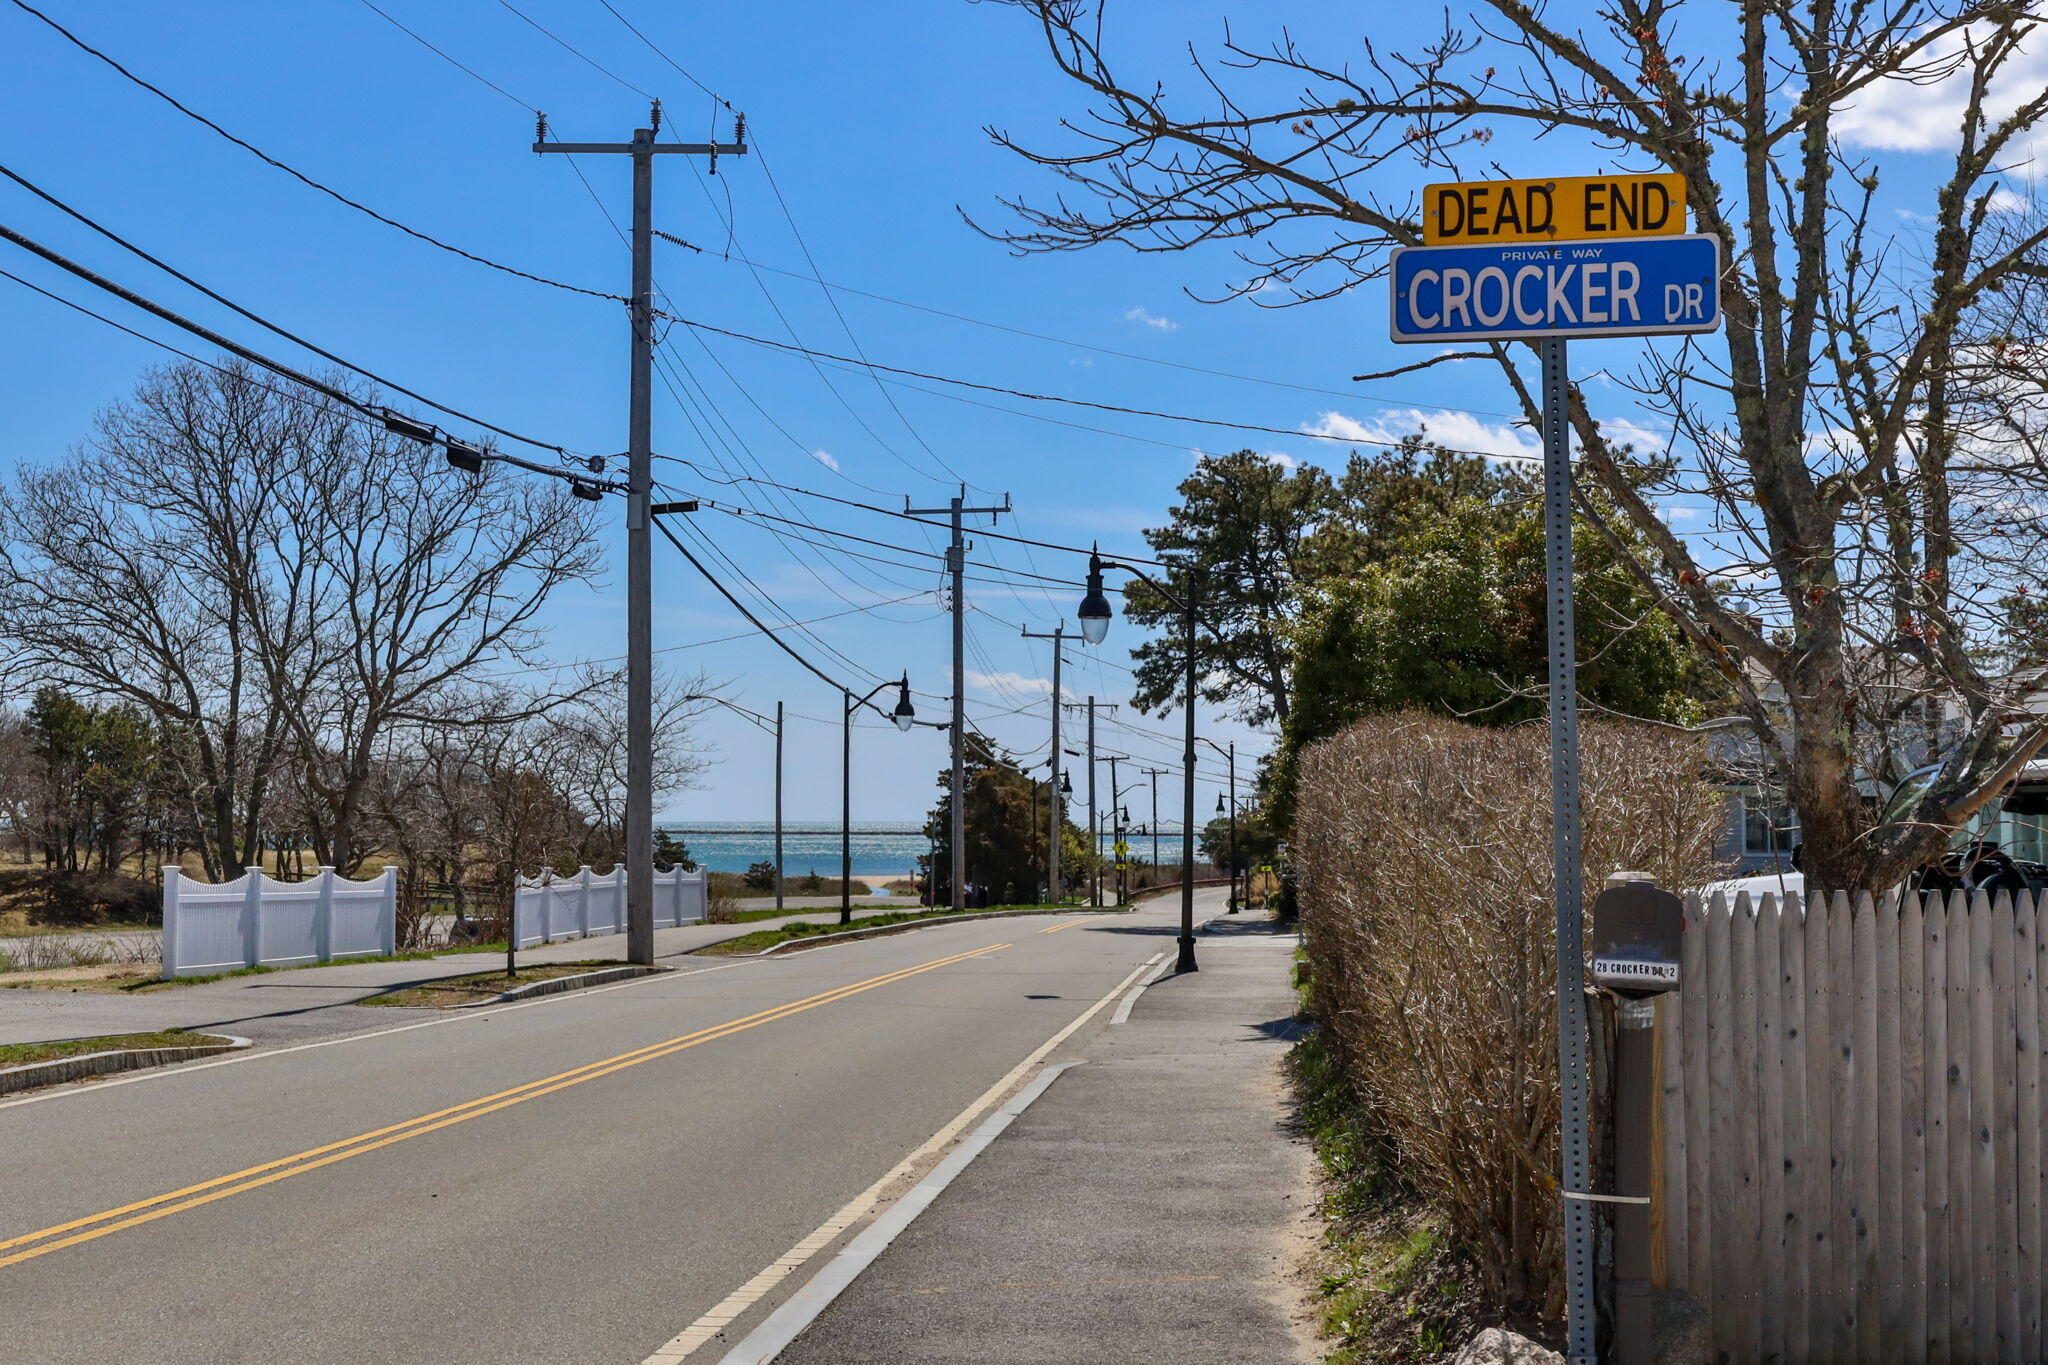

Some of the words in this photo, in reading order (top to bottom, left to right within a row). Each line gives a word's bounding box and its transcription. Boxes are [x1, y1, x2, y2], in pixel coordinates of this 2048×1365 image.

[1438, 185, 1553, 237] DEAD
[1585, 181, 1670, 232] END
[1501, 250, 1563, 261] PRIVATE
[1571, 248, 1603, 258] WAY
[1409, 261, 1641, 329] CROCKER
[1664, 283, 1703, 322] DR
[1597, 962, 1607, 973] 28
[1611, 963, 1649, 975] CROCKER
[1652, 966, 1663, 976] DR
